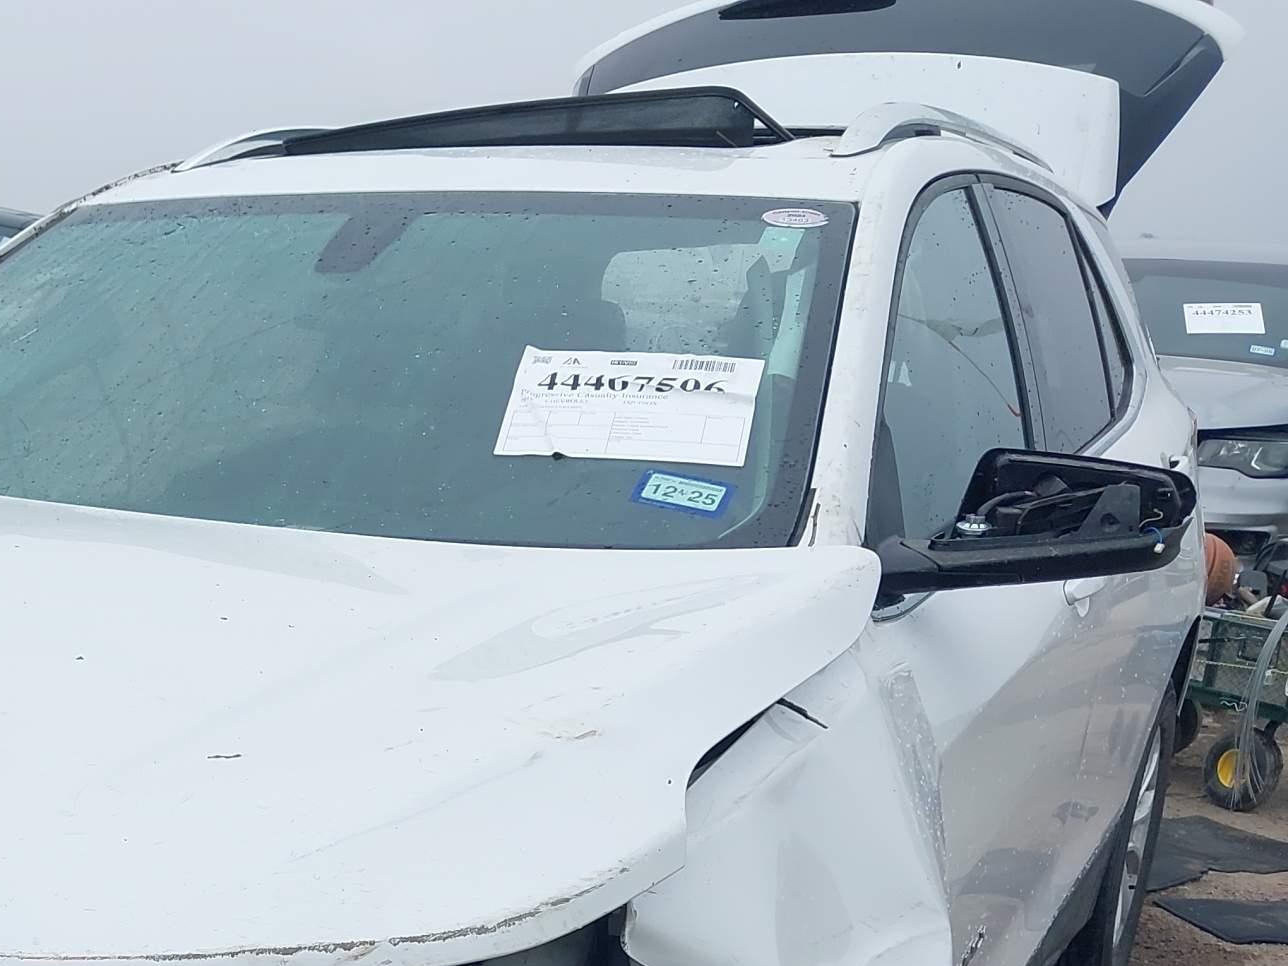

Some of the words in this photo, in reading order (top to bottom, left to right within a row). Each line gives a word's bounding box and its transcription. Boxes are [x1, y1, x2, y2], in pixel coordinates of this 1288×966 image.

[538, 372, 728, 393] 44467506
[577, 391, 617, 401] Casualty
[621, 391, 669, 400] Insurance
